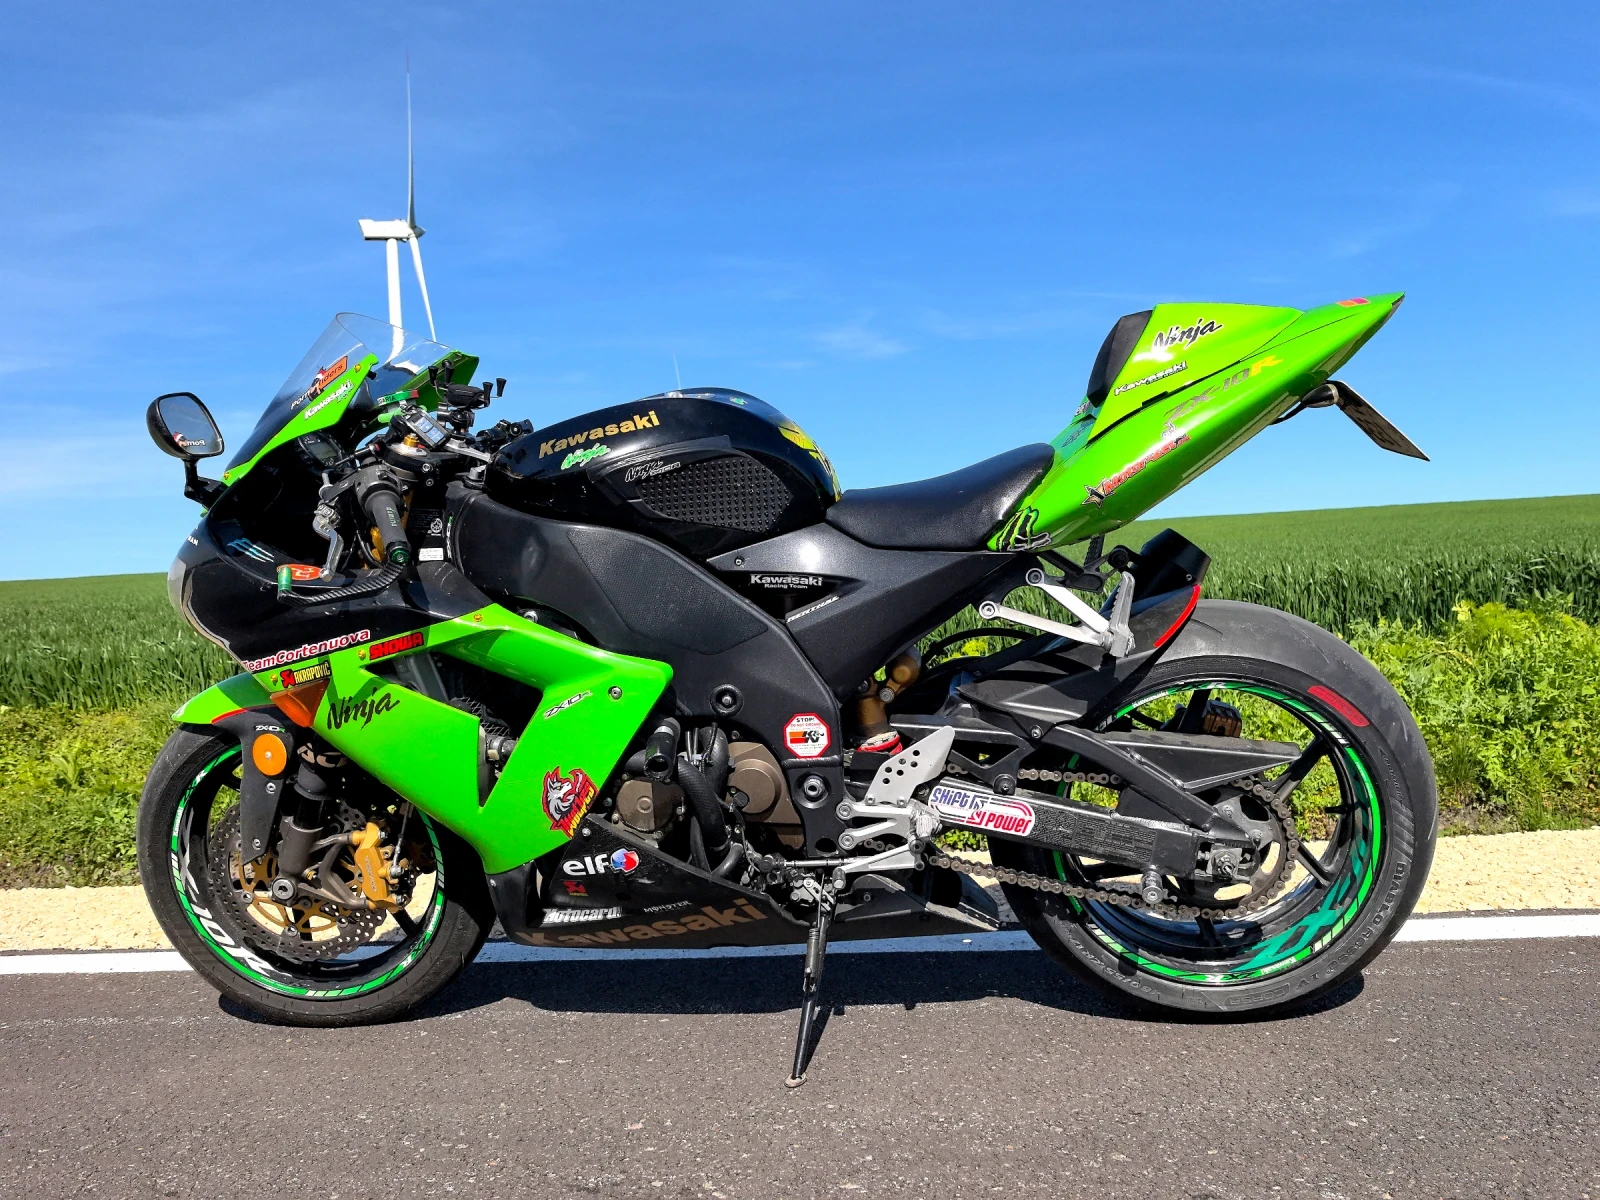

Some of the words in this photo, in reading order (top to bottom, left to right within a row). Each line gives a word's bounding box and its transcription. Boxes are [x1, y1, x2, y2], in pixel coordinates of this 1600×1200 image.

[1153, 318, 1223, 350] Ninja
[1114, 360, 1188, 396] Kawasaki
[539, 410, 660, 459] Kawasaki
[750, 574, 823, 587] Kawasaki
[369, 632, 424, 661] SHOWA
[327, 687, 400, 730] Ninja
[562, 853, 610, 876] elf
[1373, 860, 1408, 926] DIABLO
[514, 898, 768, 946] Kawasaki
